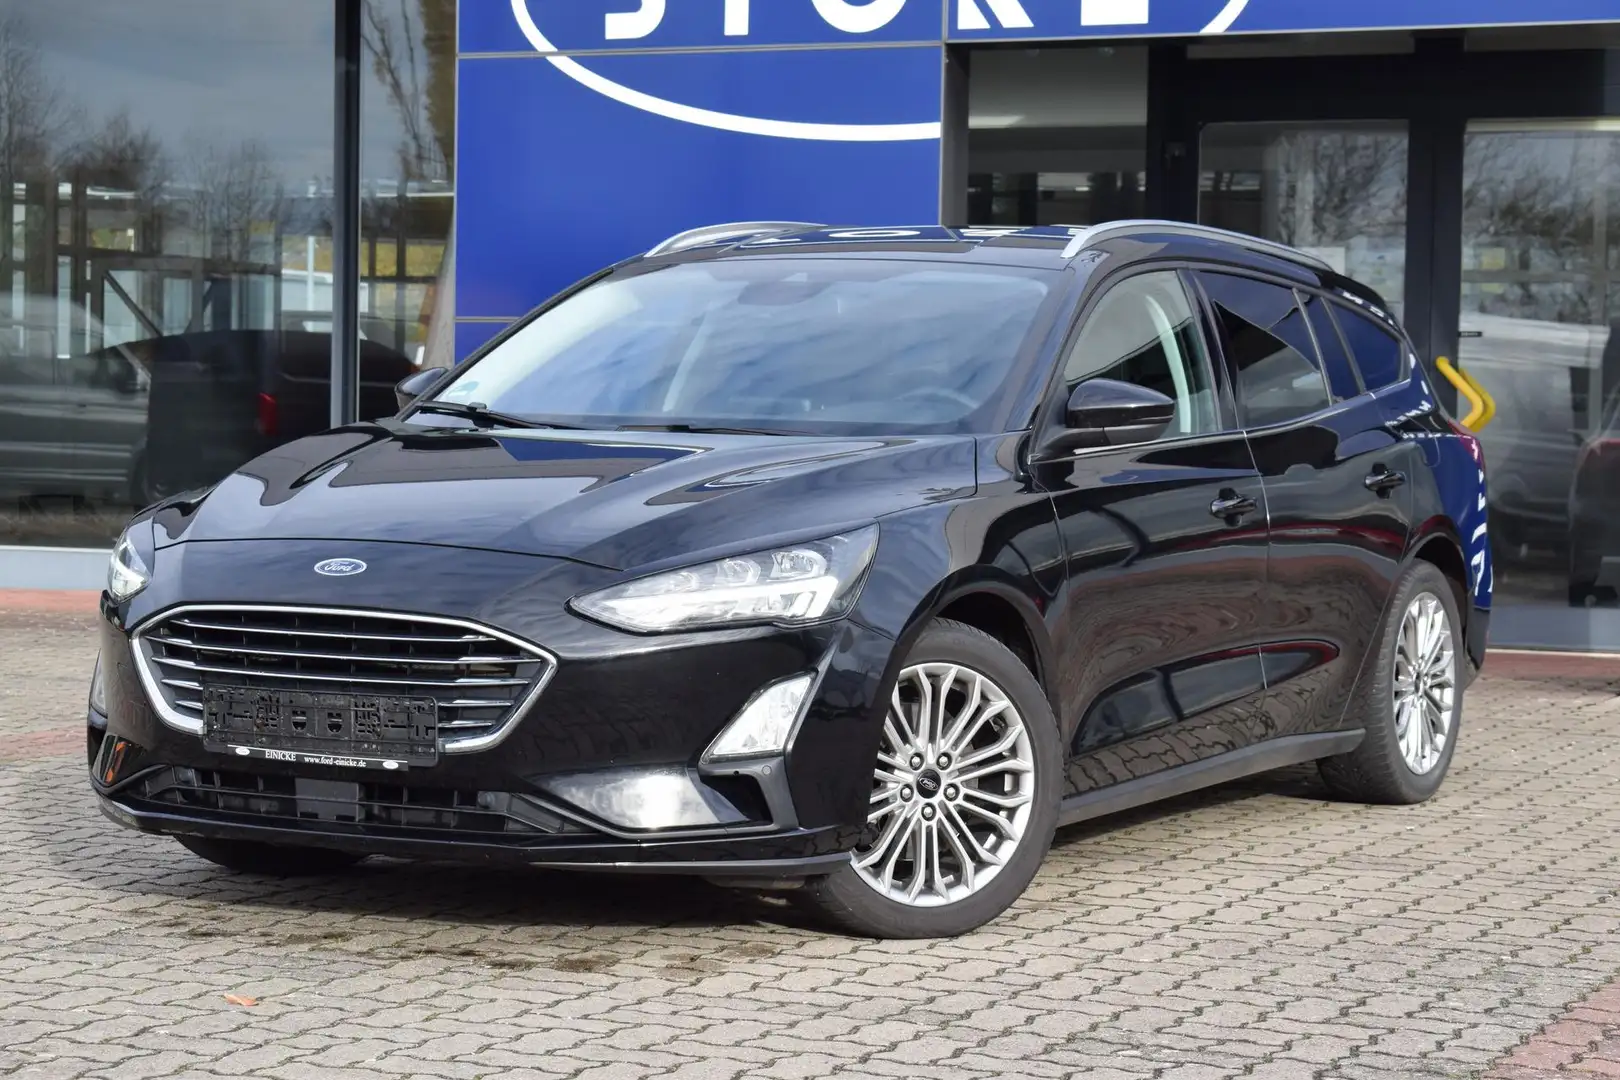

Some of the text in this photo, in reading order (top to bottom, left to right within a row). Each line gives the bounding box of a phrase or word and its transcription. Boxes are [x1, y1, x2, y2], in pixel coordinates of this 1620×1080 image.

[324, 561, 355, 571] Ford
[265, 750, 367, 767] EINICKE www.ford-einicke.de
